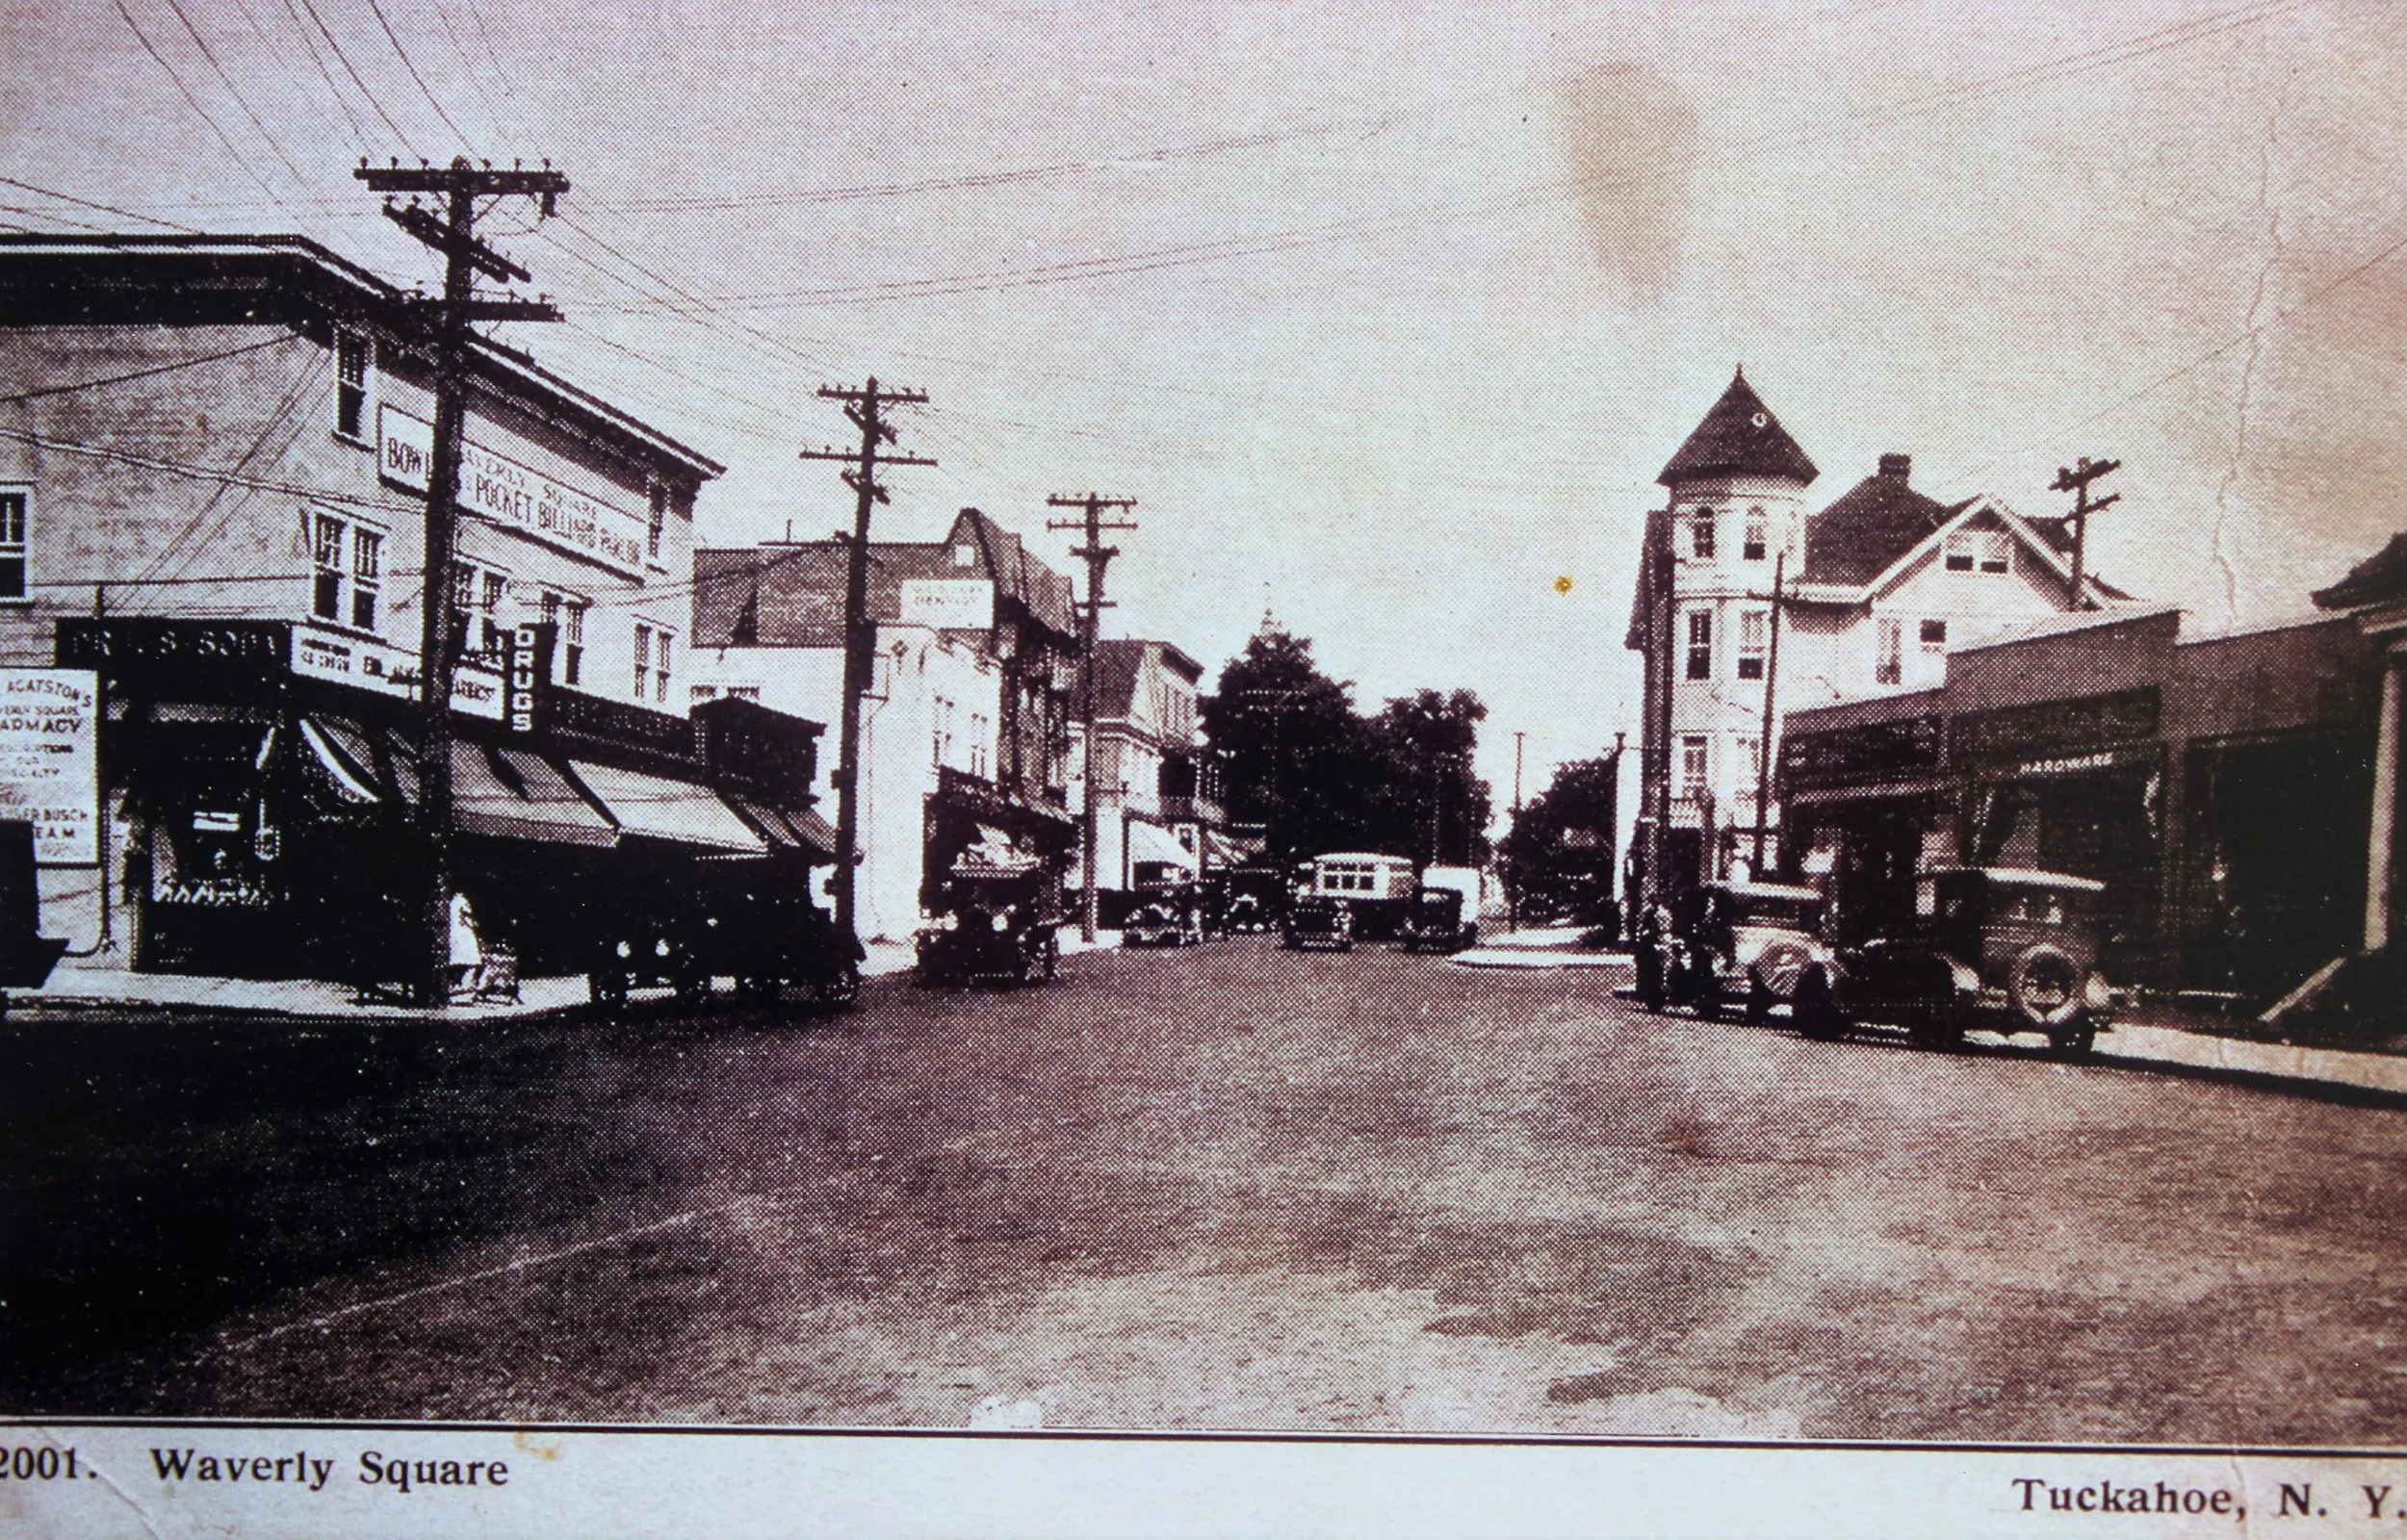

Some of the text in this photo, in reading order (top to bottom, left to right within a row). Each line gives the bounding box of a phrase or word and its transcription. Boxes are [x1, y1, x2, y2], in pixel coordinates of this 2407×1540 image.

[465, 448, 527, 489] AVERLY
[475, 473, 532, 524] POCKET
[512, 629, 535, 732] DRUGS
[2019, 752, 2113, 774] HARDWARE
[34, 826, 77, 840] EAM
